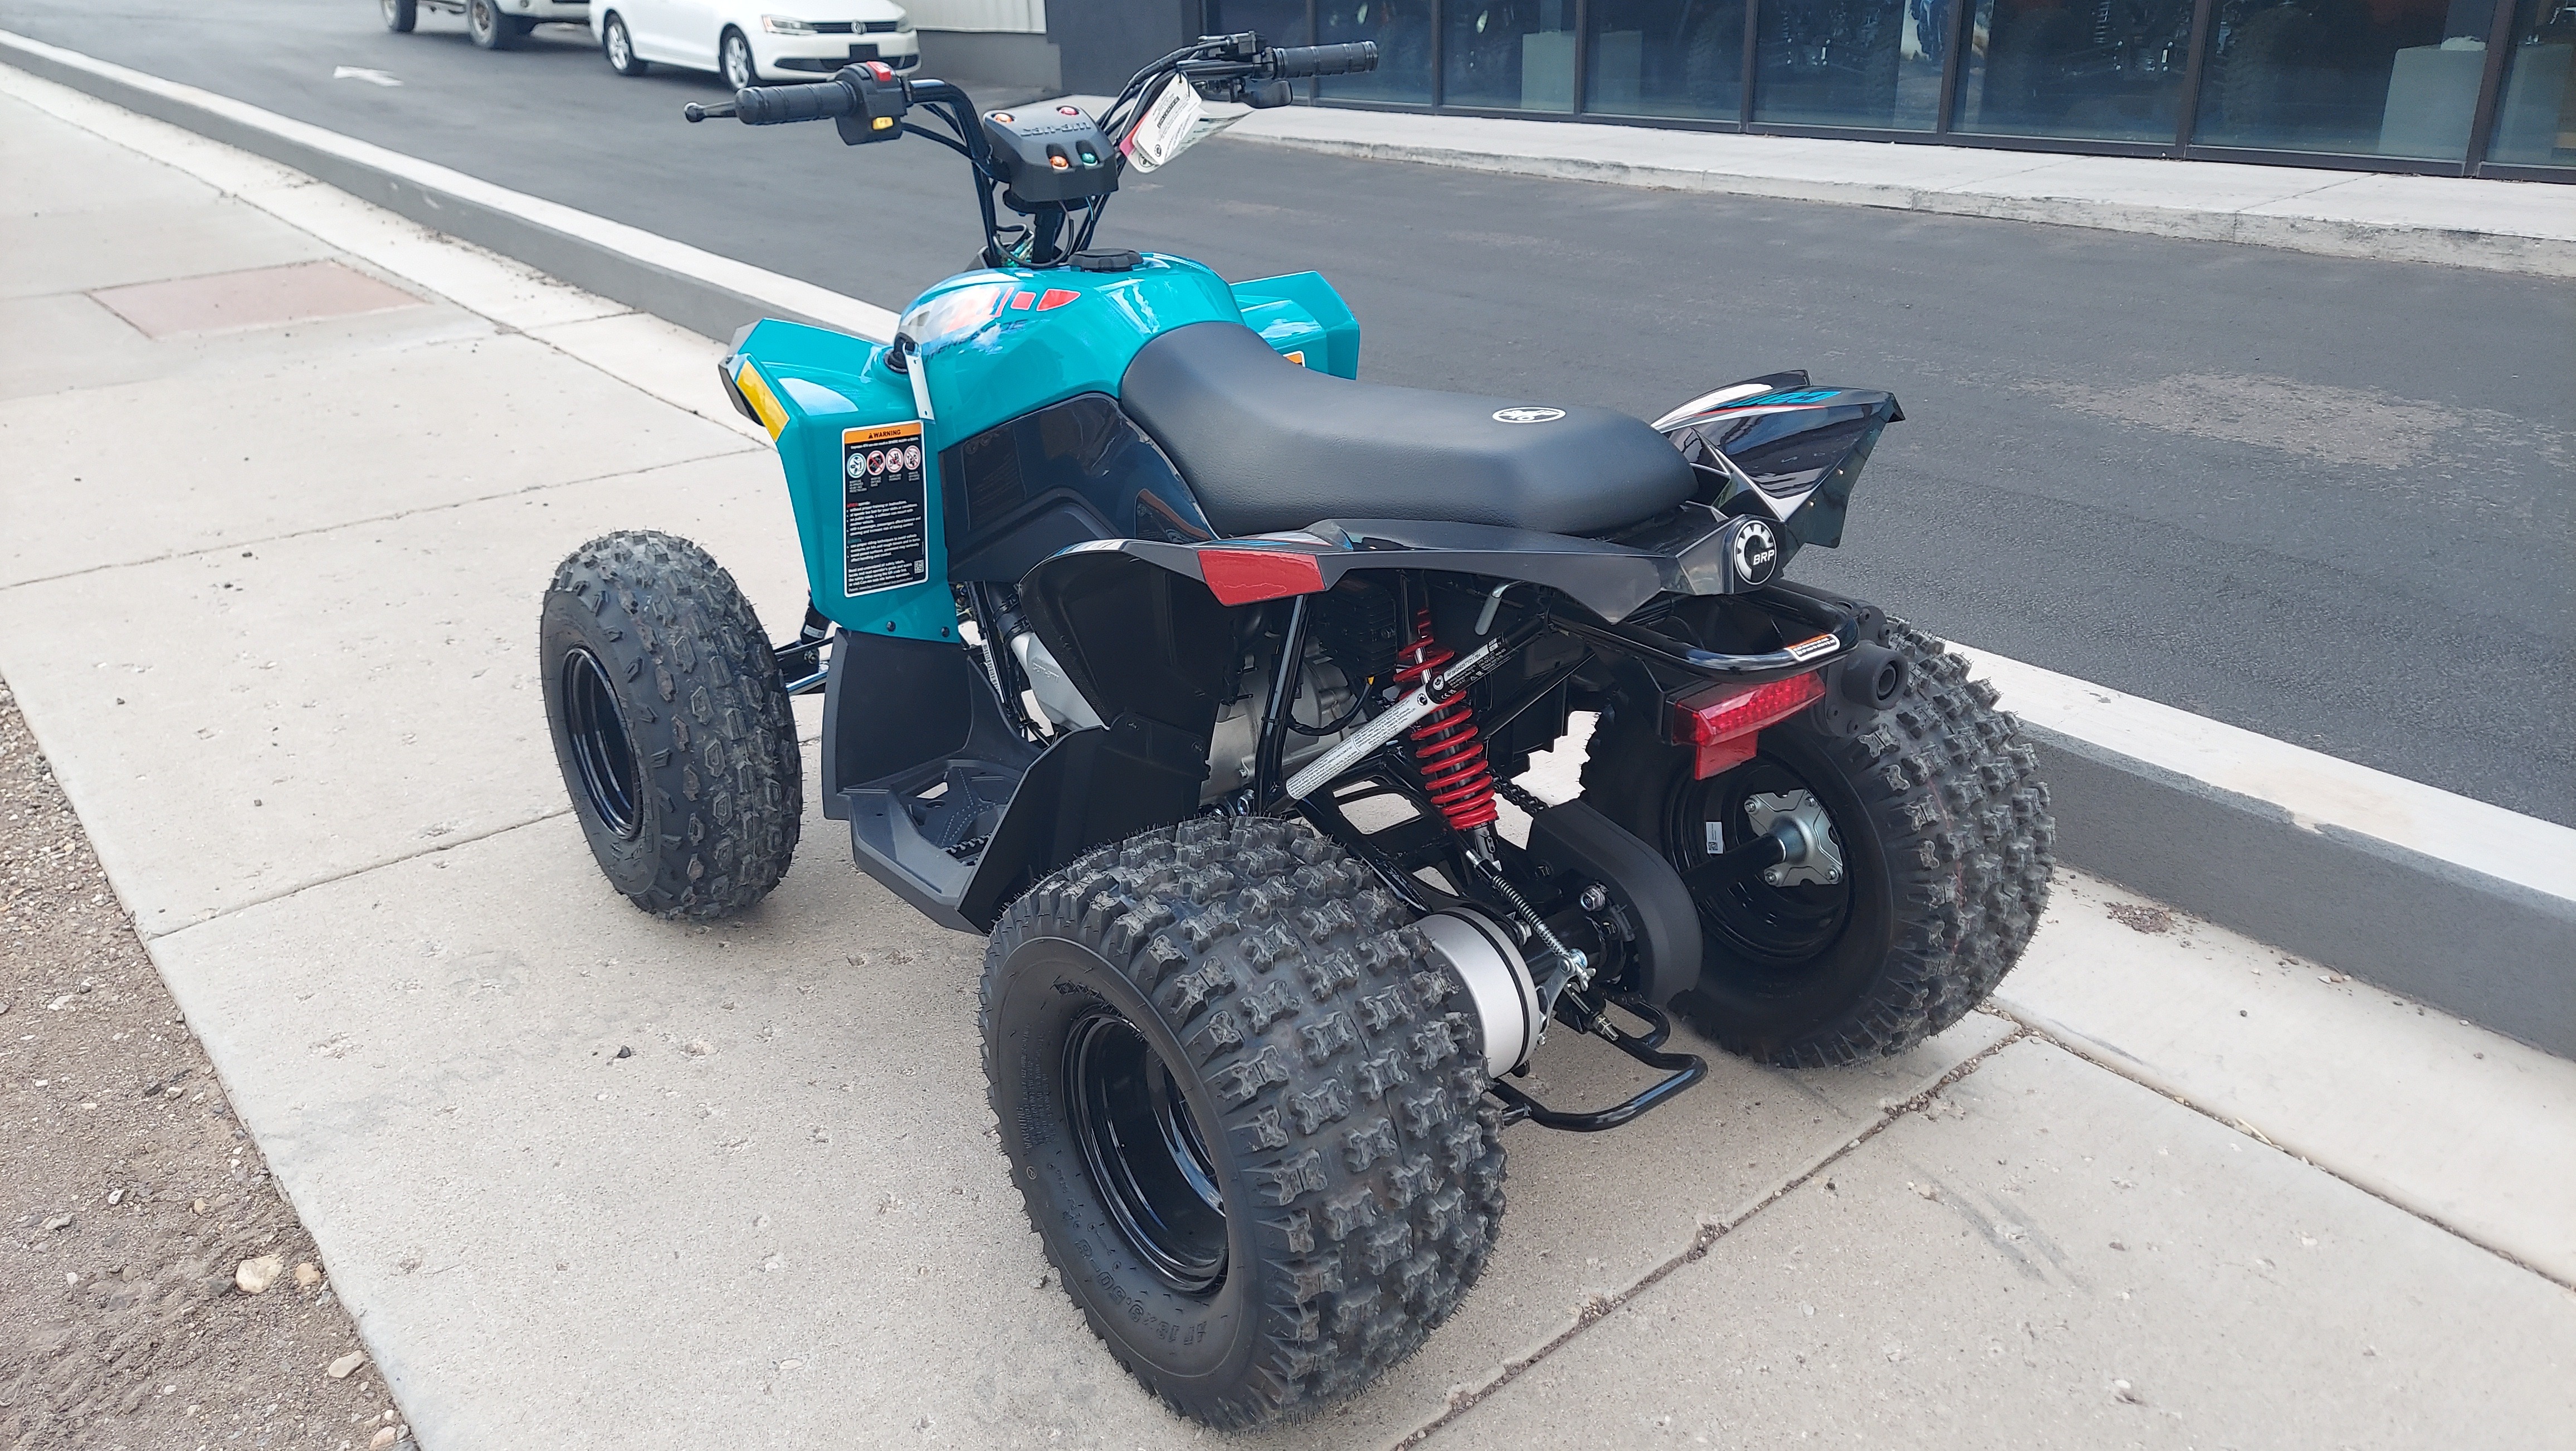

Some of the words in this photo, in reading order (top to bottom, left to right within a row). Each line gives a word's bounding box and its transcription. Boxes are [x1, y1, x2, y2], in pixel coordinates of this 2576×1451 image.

[1021, 121, 1091, 137] can-am
[874, 429, 901, 439] WARNING
[1753, 549, 1775, 566] BRP
